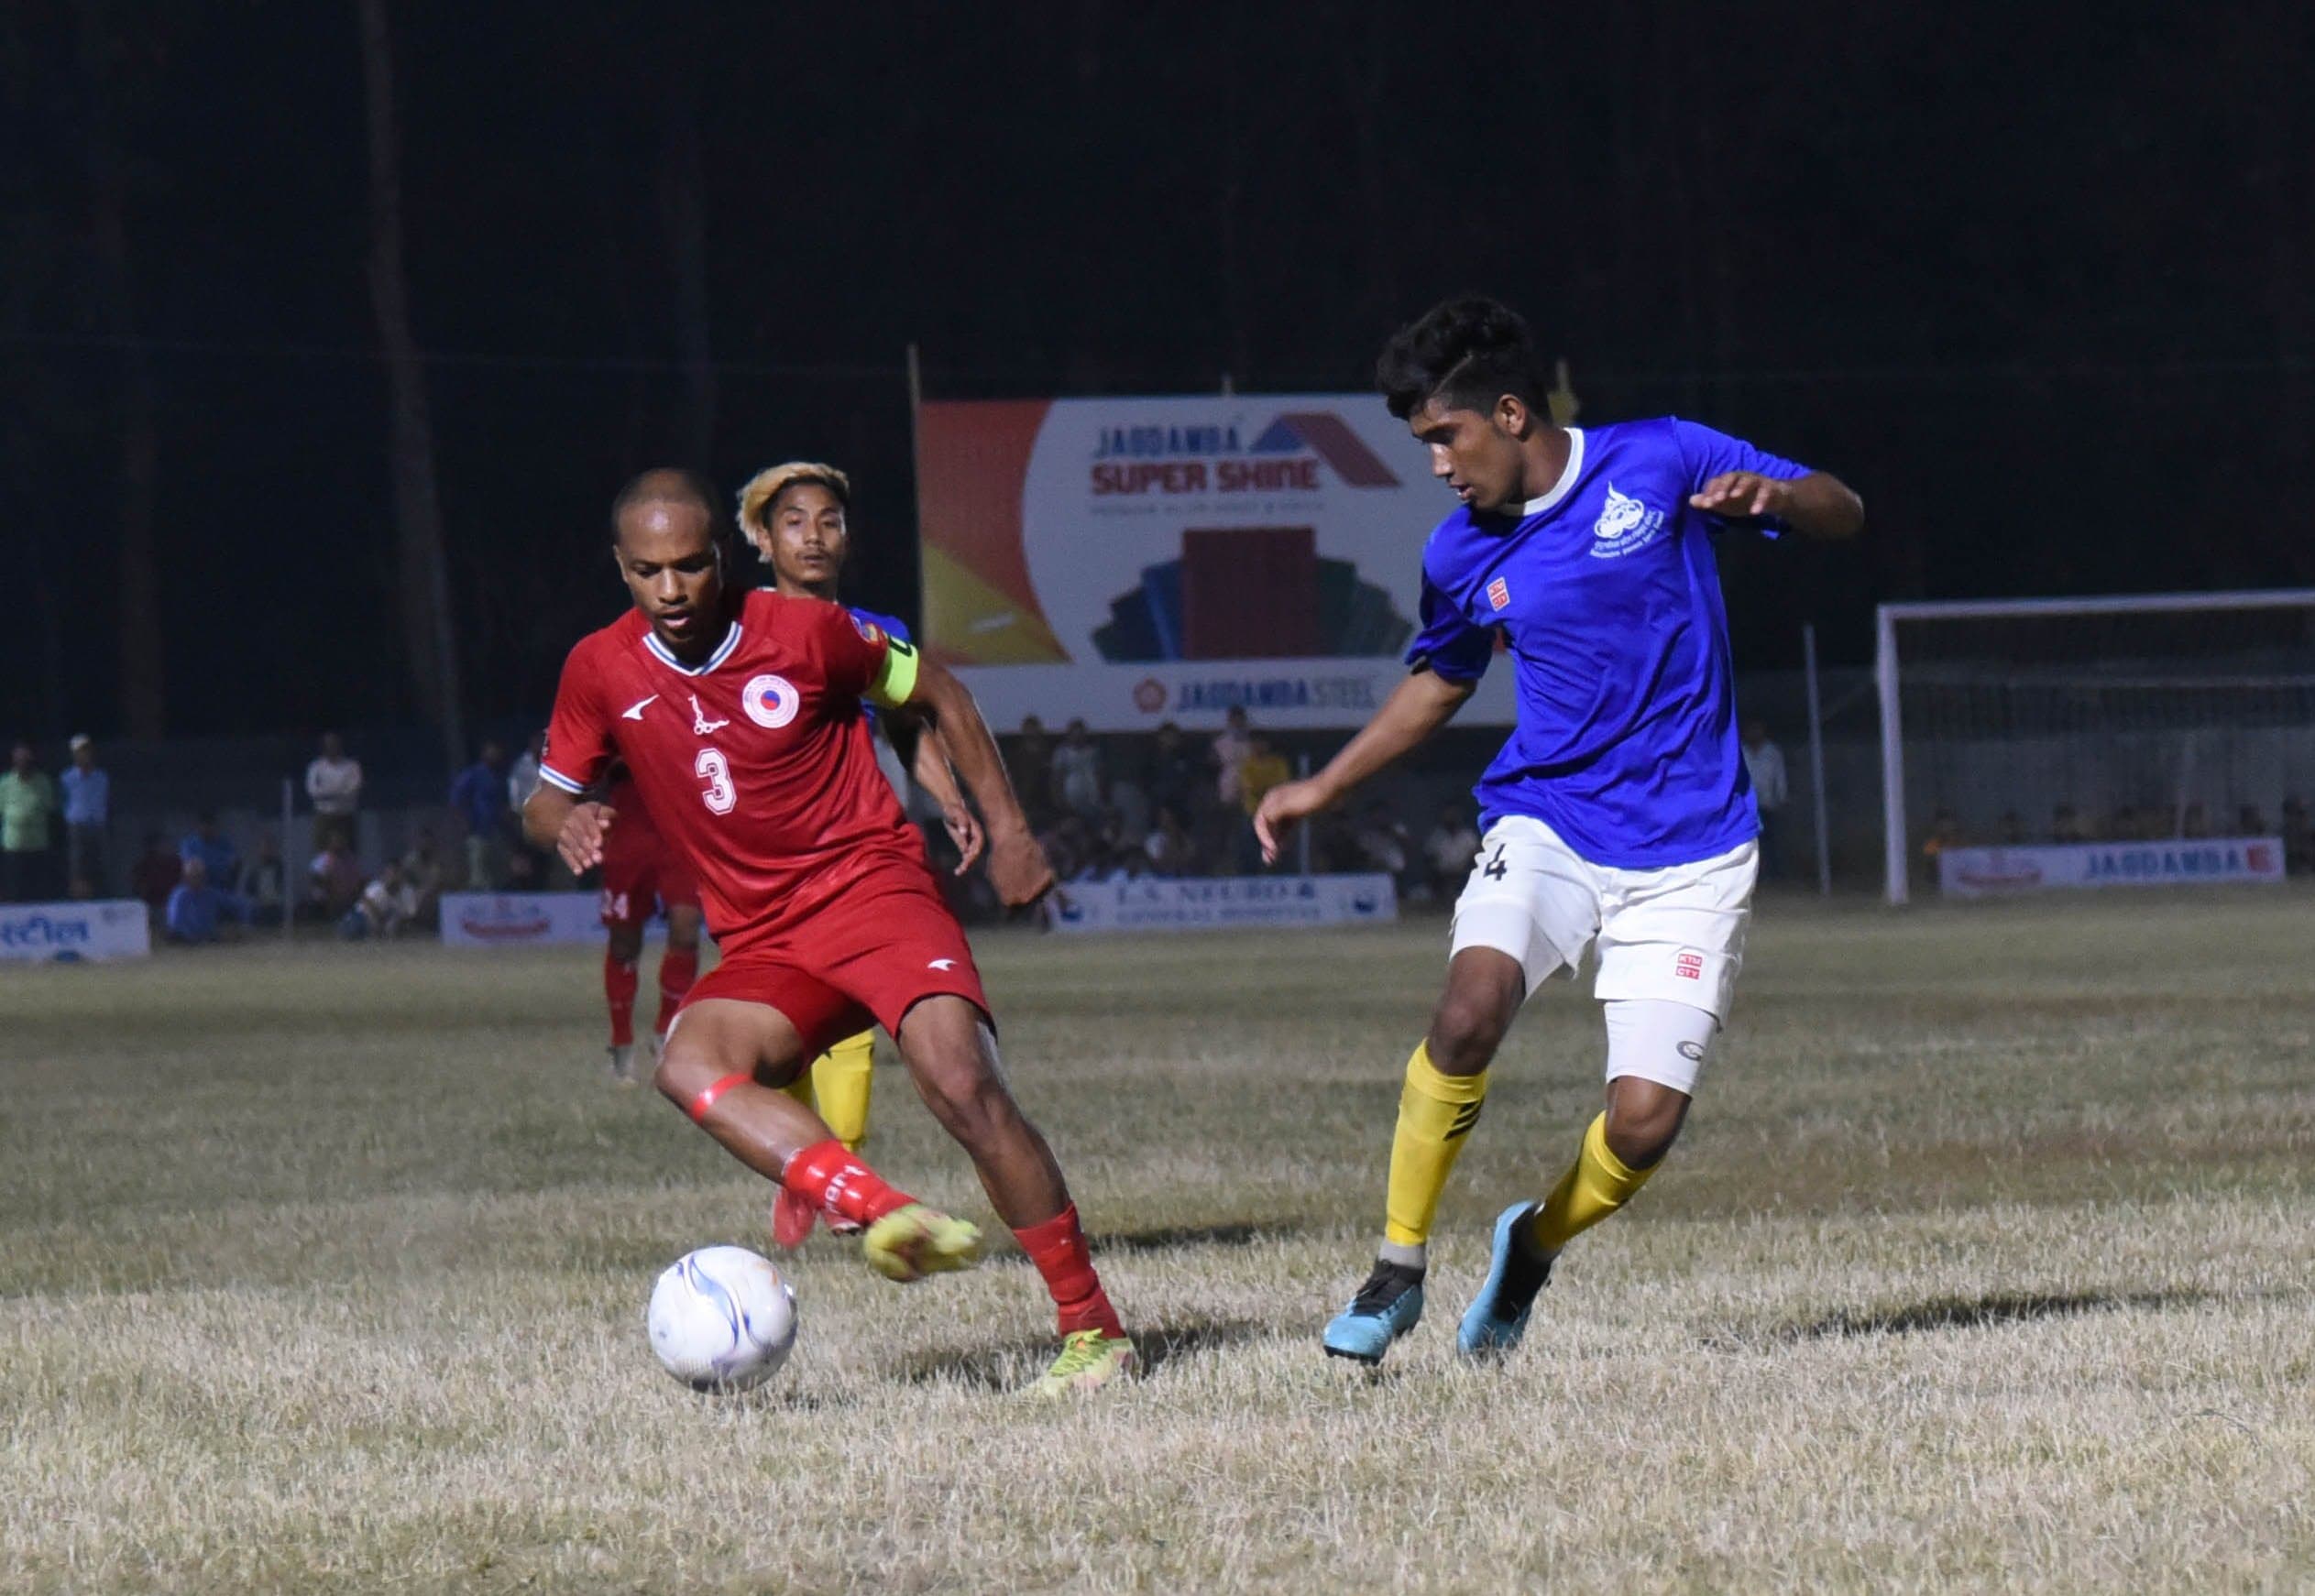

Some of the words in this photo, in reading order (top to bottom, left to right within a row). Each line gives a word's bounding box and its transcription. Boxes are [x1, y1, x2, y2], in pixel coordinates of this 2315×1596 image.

[1093, 425, 1241, 457] JAGDAMBA
[1092, 463, 1207, 496] SUPER
[1215, 460, 1320, 492] SHINE
[695, 748, 737, 815] 3
[1676, 967, 1699, 978] CTY
[1678, 954, 1702, 967] KTM
